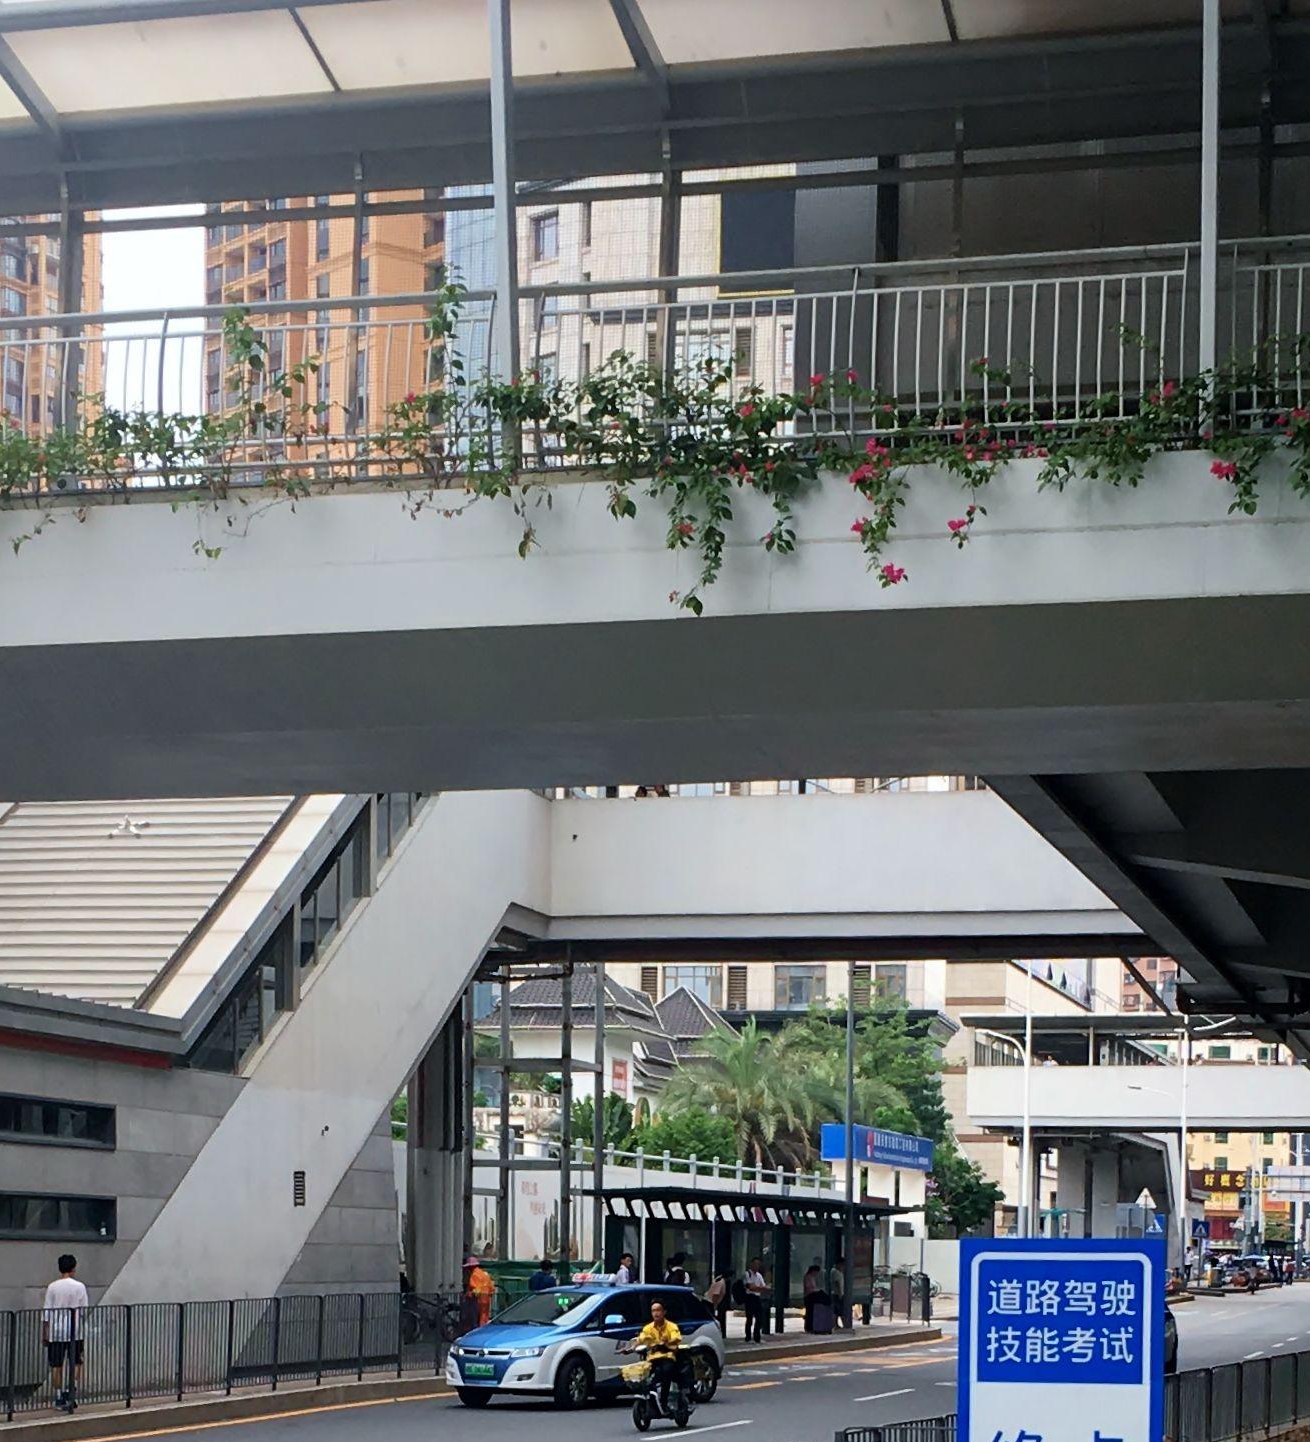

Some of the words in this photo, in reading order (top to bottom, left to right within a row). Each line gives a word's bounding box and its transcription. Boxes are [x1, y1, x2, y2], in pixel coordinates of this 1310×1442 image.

[987, 1279, 1136, 1316] 道路驾驶
[987, 1326, 1134, 1363] 技能考试
